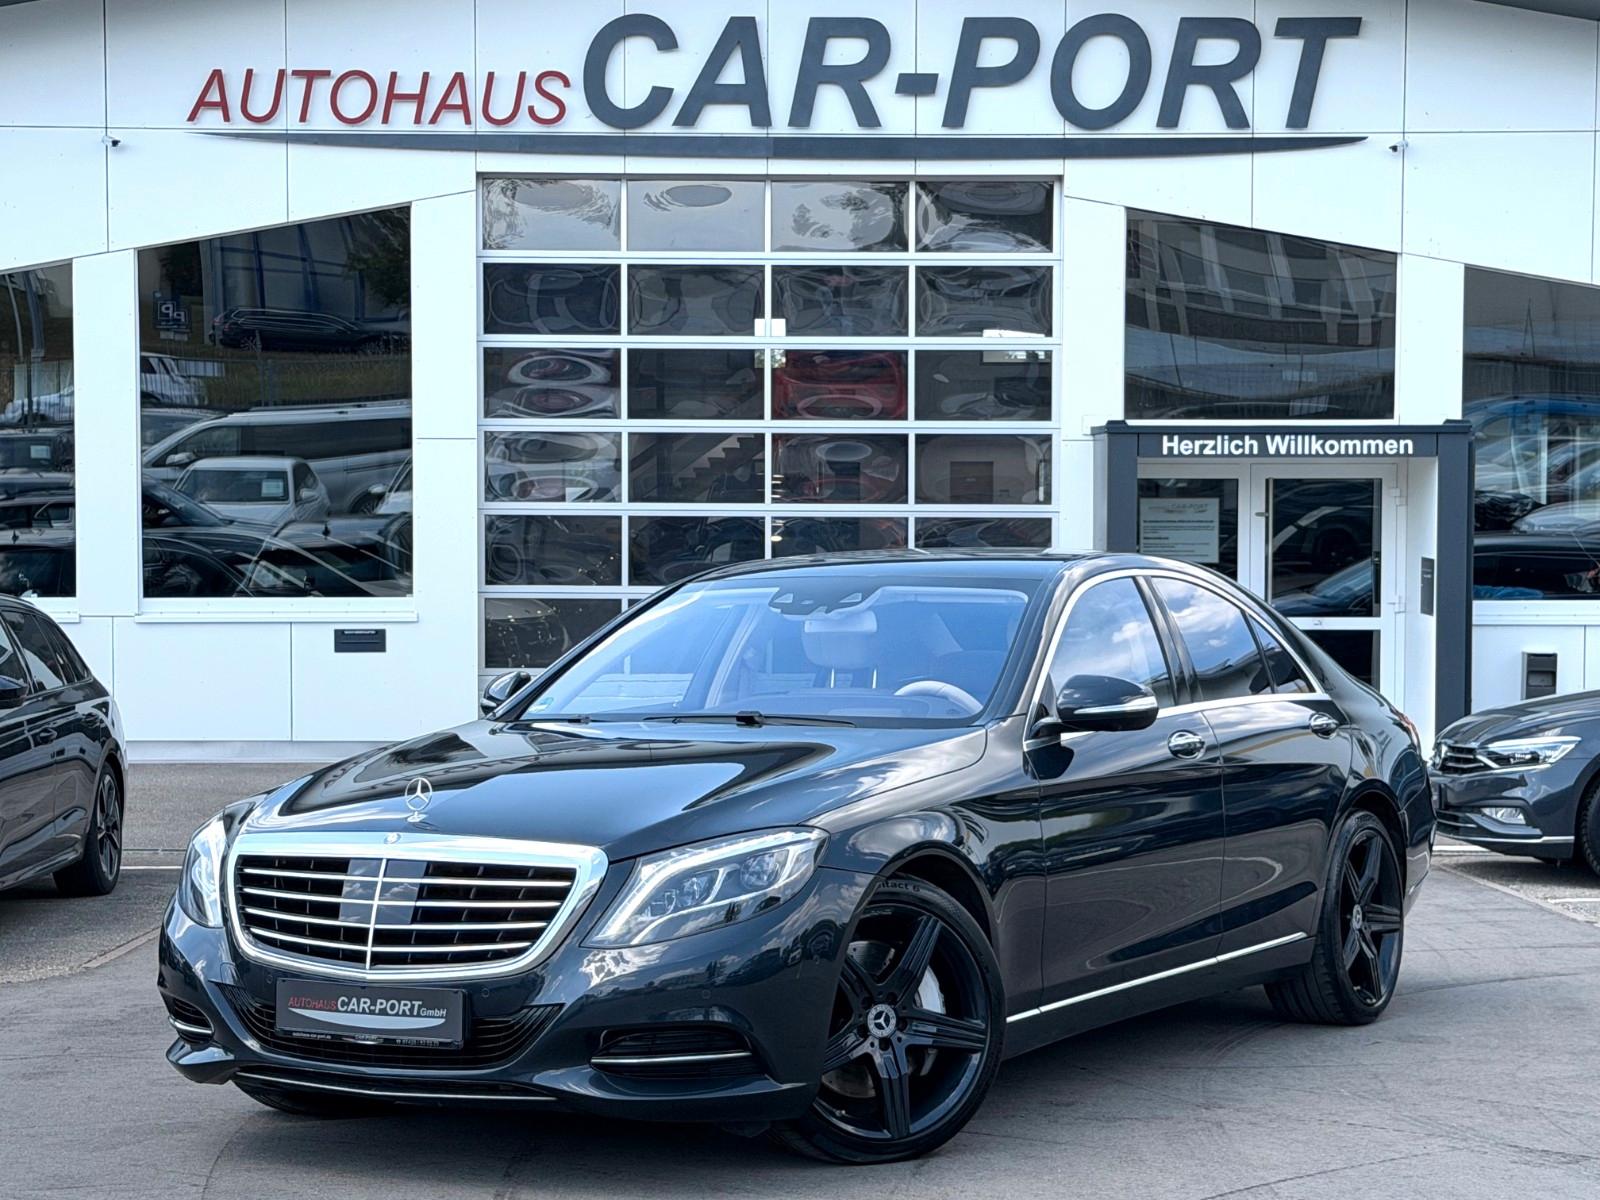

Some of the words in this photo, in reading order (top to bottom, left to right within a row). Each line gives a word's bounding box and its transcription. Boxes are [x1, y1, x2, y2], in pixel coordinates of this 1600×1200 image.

[187, 68, 571, 126] AUTOHAUS
[583, 13, 1363, 131] CAR-PORT
[1162, 434, 1258, 456] Herzlich
[1265, 434, 1414, 456] Willkommen
[287, 996, 337, 1011] AUTOHAUS
[337, 996, 423, 1016] CAR-PORT
[420, 1007, 447, 1018] GmbH
